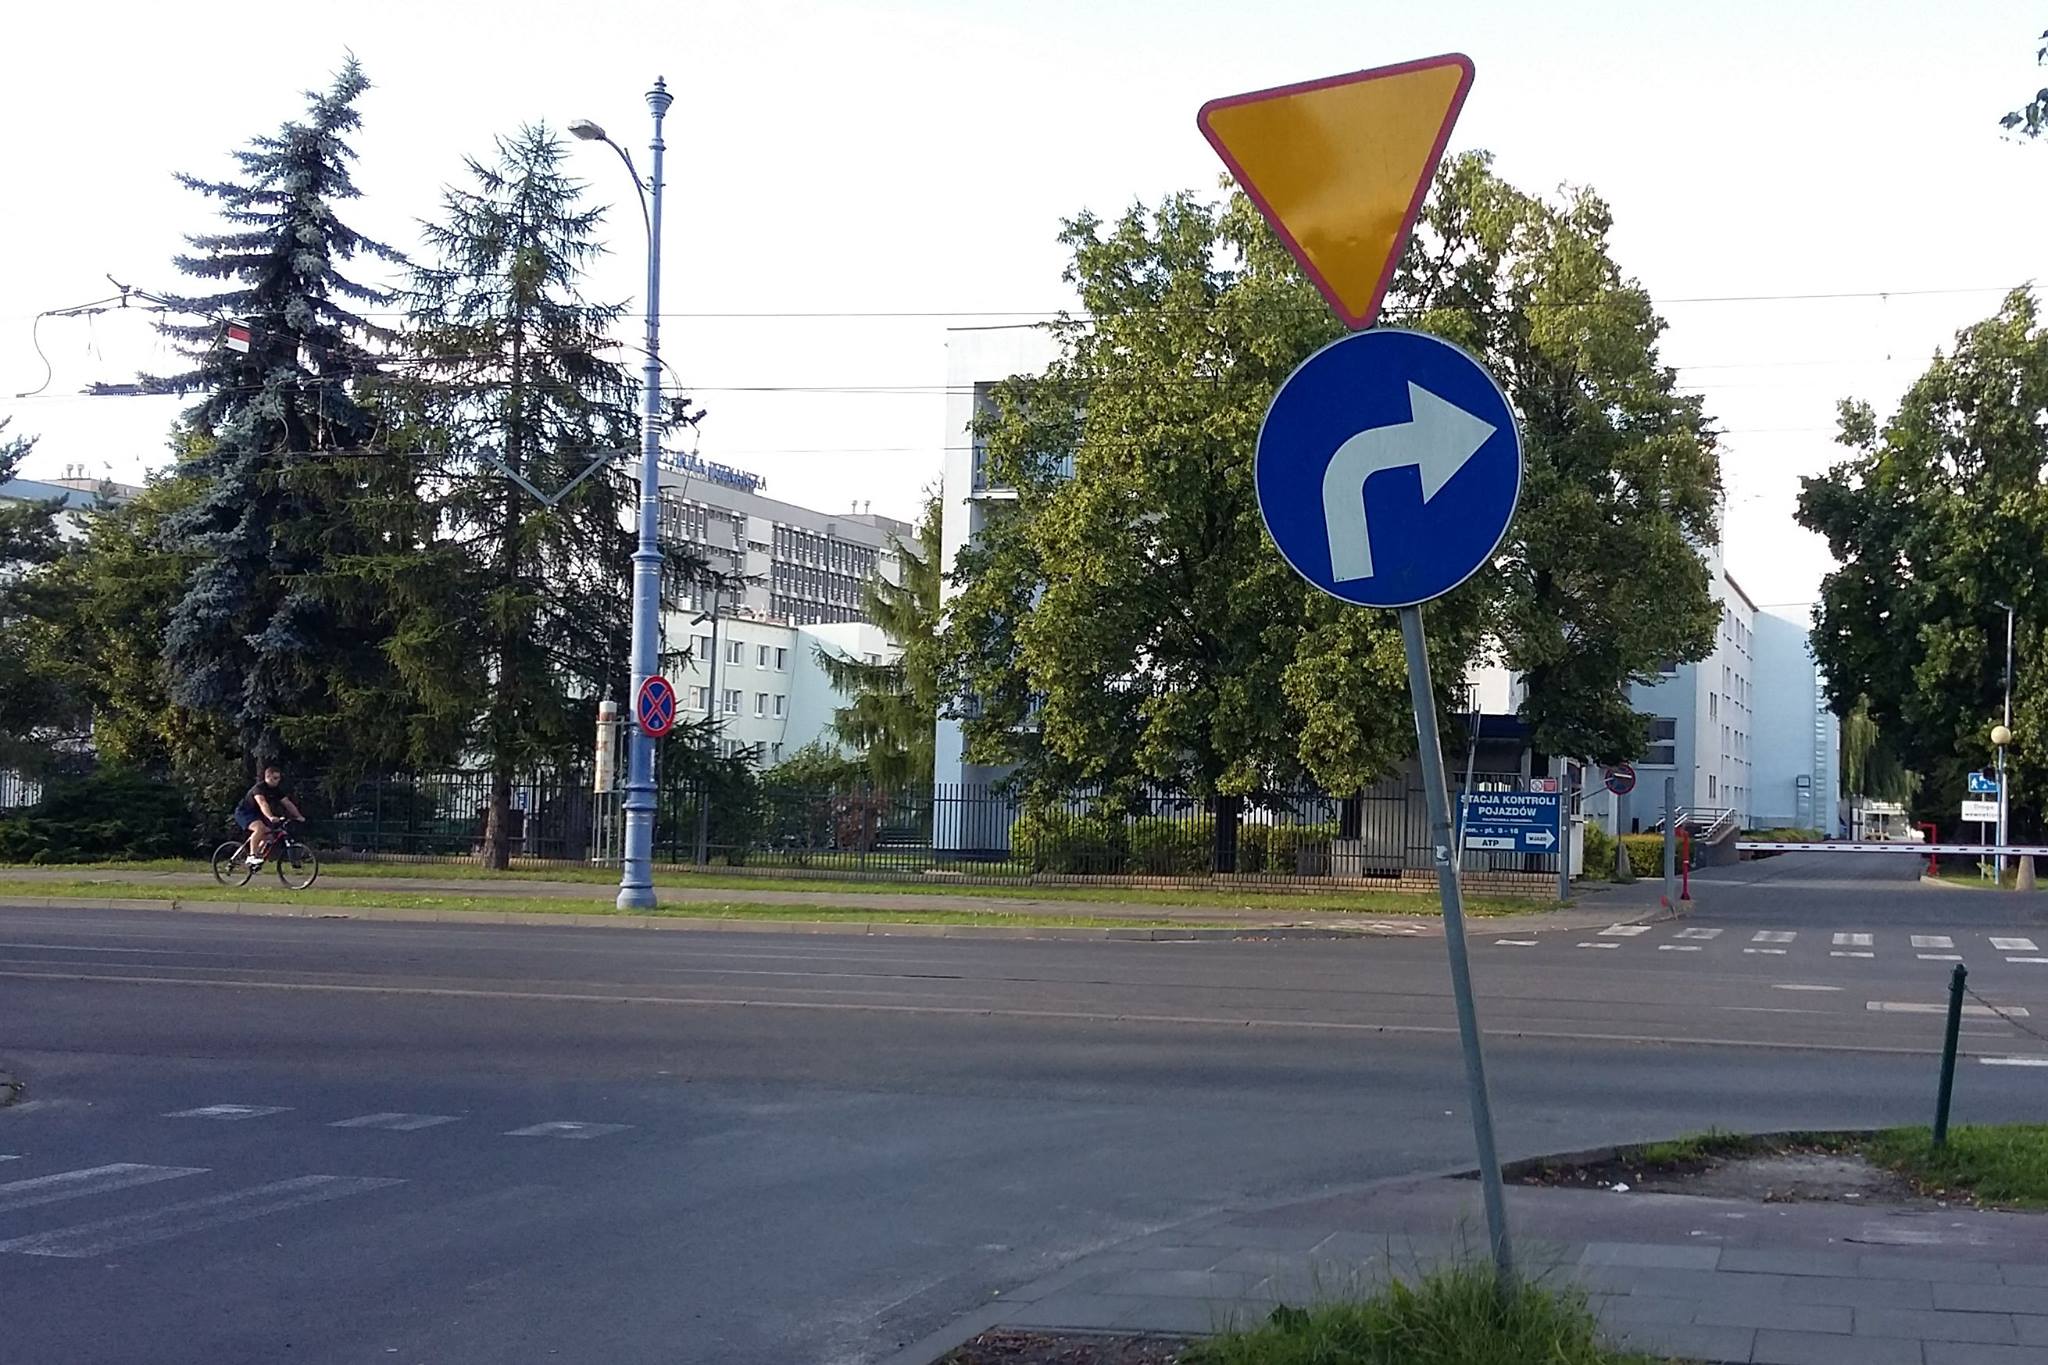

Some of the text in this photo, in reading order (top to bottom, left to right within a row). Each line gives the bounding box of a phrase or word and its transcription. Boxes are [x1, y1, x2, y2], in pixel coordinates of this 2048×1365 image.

[1460, 795, 1556, 805] STACJA KONTROLI
[1478, 806, 1537, 816] POJAZDÓW
[1482, 839, 1500, 847] ATP
